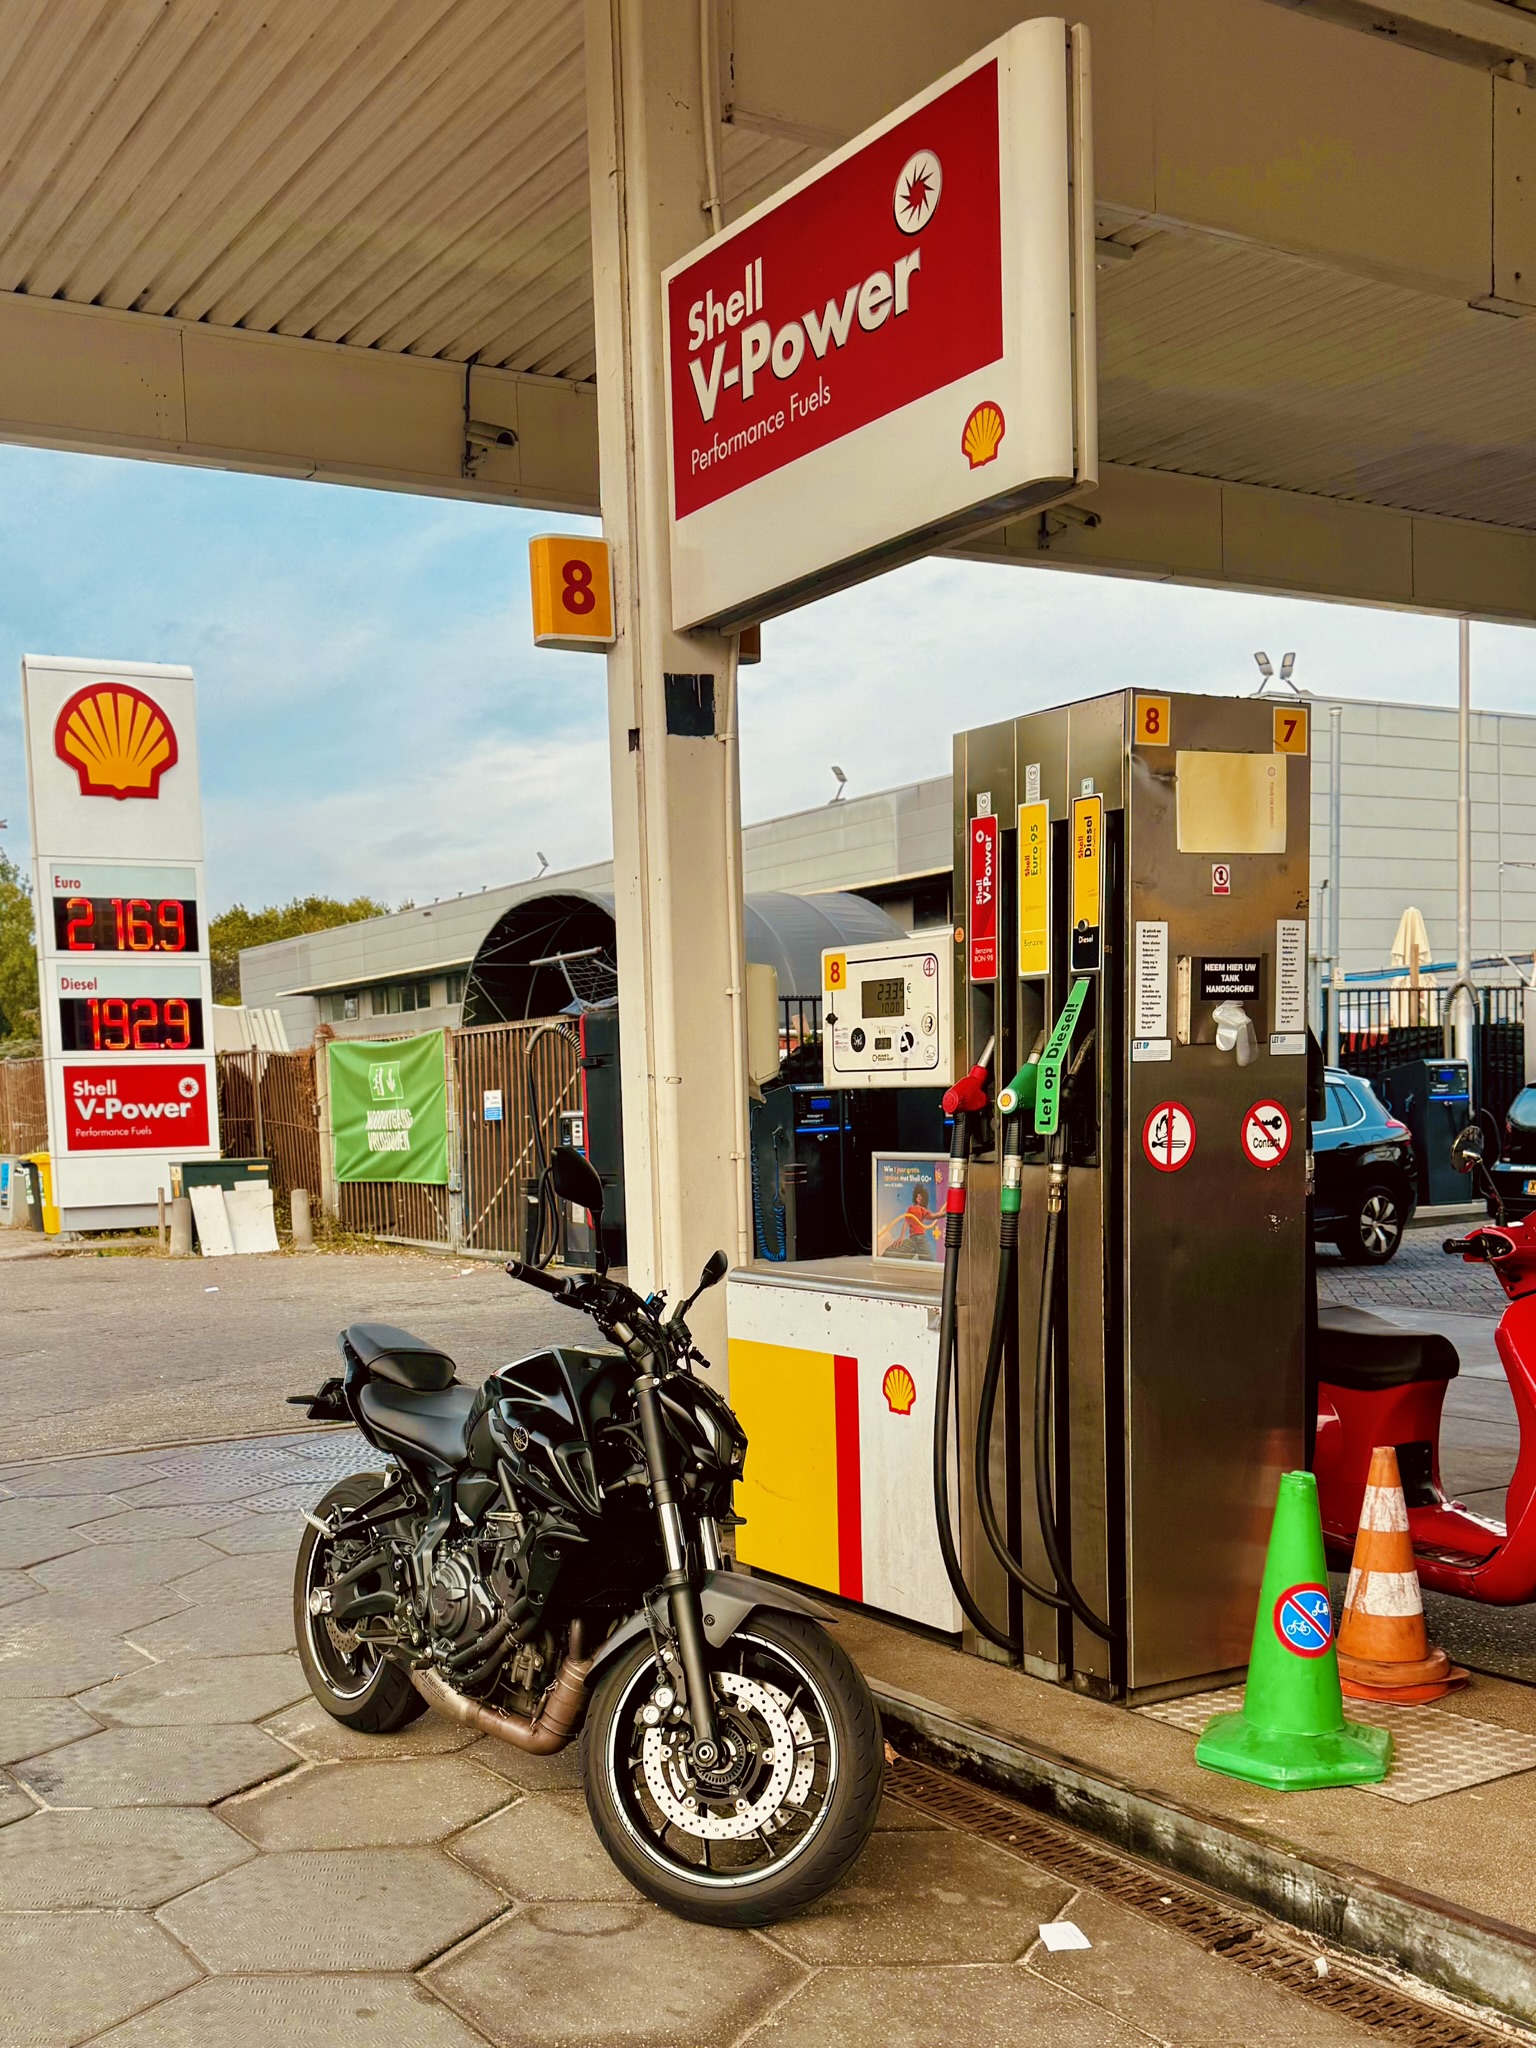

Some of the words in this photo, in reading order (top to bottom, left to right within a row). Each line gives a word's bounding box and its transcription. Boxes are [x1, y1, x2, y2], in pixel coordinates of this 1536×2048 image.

[688, 256, 763, 351] Shell
[688, 247, 921, 424] V-Power
[691, 411, 785, 475] Performance
[790, 376, 831, 422] Fuels
[562, 559, 595, 615] 8
[1145, 707, 1160, 734] 8
[1283, 719, 1298, 743] 7
[1030, 824, 1039, 842] 95
[1084, 815, 1093, 858] Diesel
[983, 834, 992, 905] V-Power
[1030, 846, 1039, 876] Euro
[54, 875, 82, 889] Euro
[1024, 939, 1044, 947] Benzine
[1078, 934, 1094, 944] Diesel
[974, 947, 993, 955] Benzine
[830, 961, 840, 983] 8
[1204, 963, 1226, 971] NEEM
[1226, 963, 1244, 971] HIER
[1244, 963, 1257, 971] UW
[1220, 974, 1240, 982] TANK
[61, 977, 98, 990] Diesel
[1205, 985, 1254, 993] HANDSCHOEN
[87, 998, 191, 1050] 192.9
[1046, 1003, 1079, 1059] Diesel!
[1134, 1042, 1142, 1050] LET
[73, 1079, 117, 1097] Shell
[1044, 1066, 1056, 1090] op
[74, 1098, 192, 1120] V-Power
[1040, 1097, 1052, 1126] Let
[75, 1127, 129, 1137] Performance
[131, 1125, 152, 1136] Fuels
[1253, 1137, 1280, 1149] Contact
